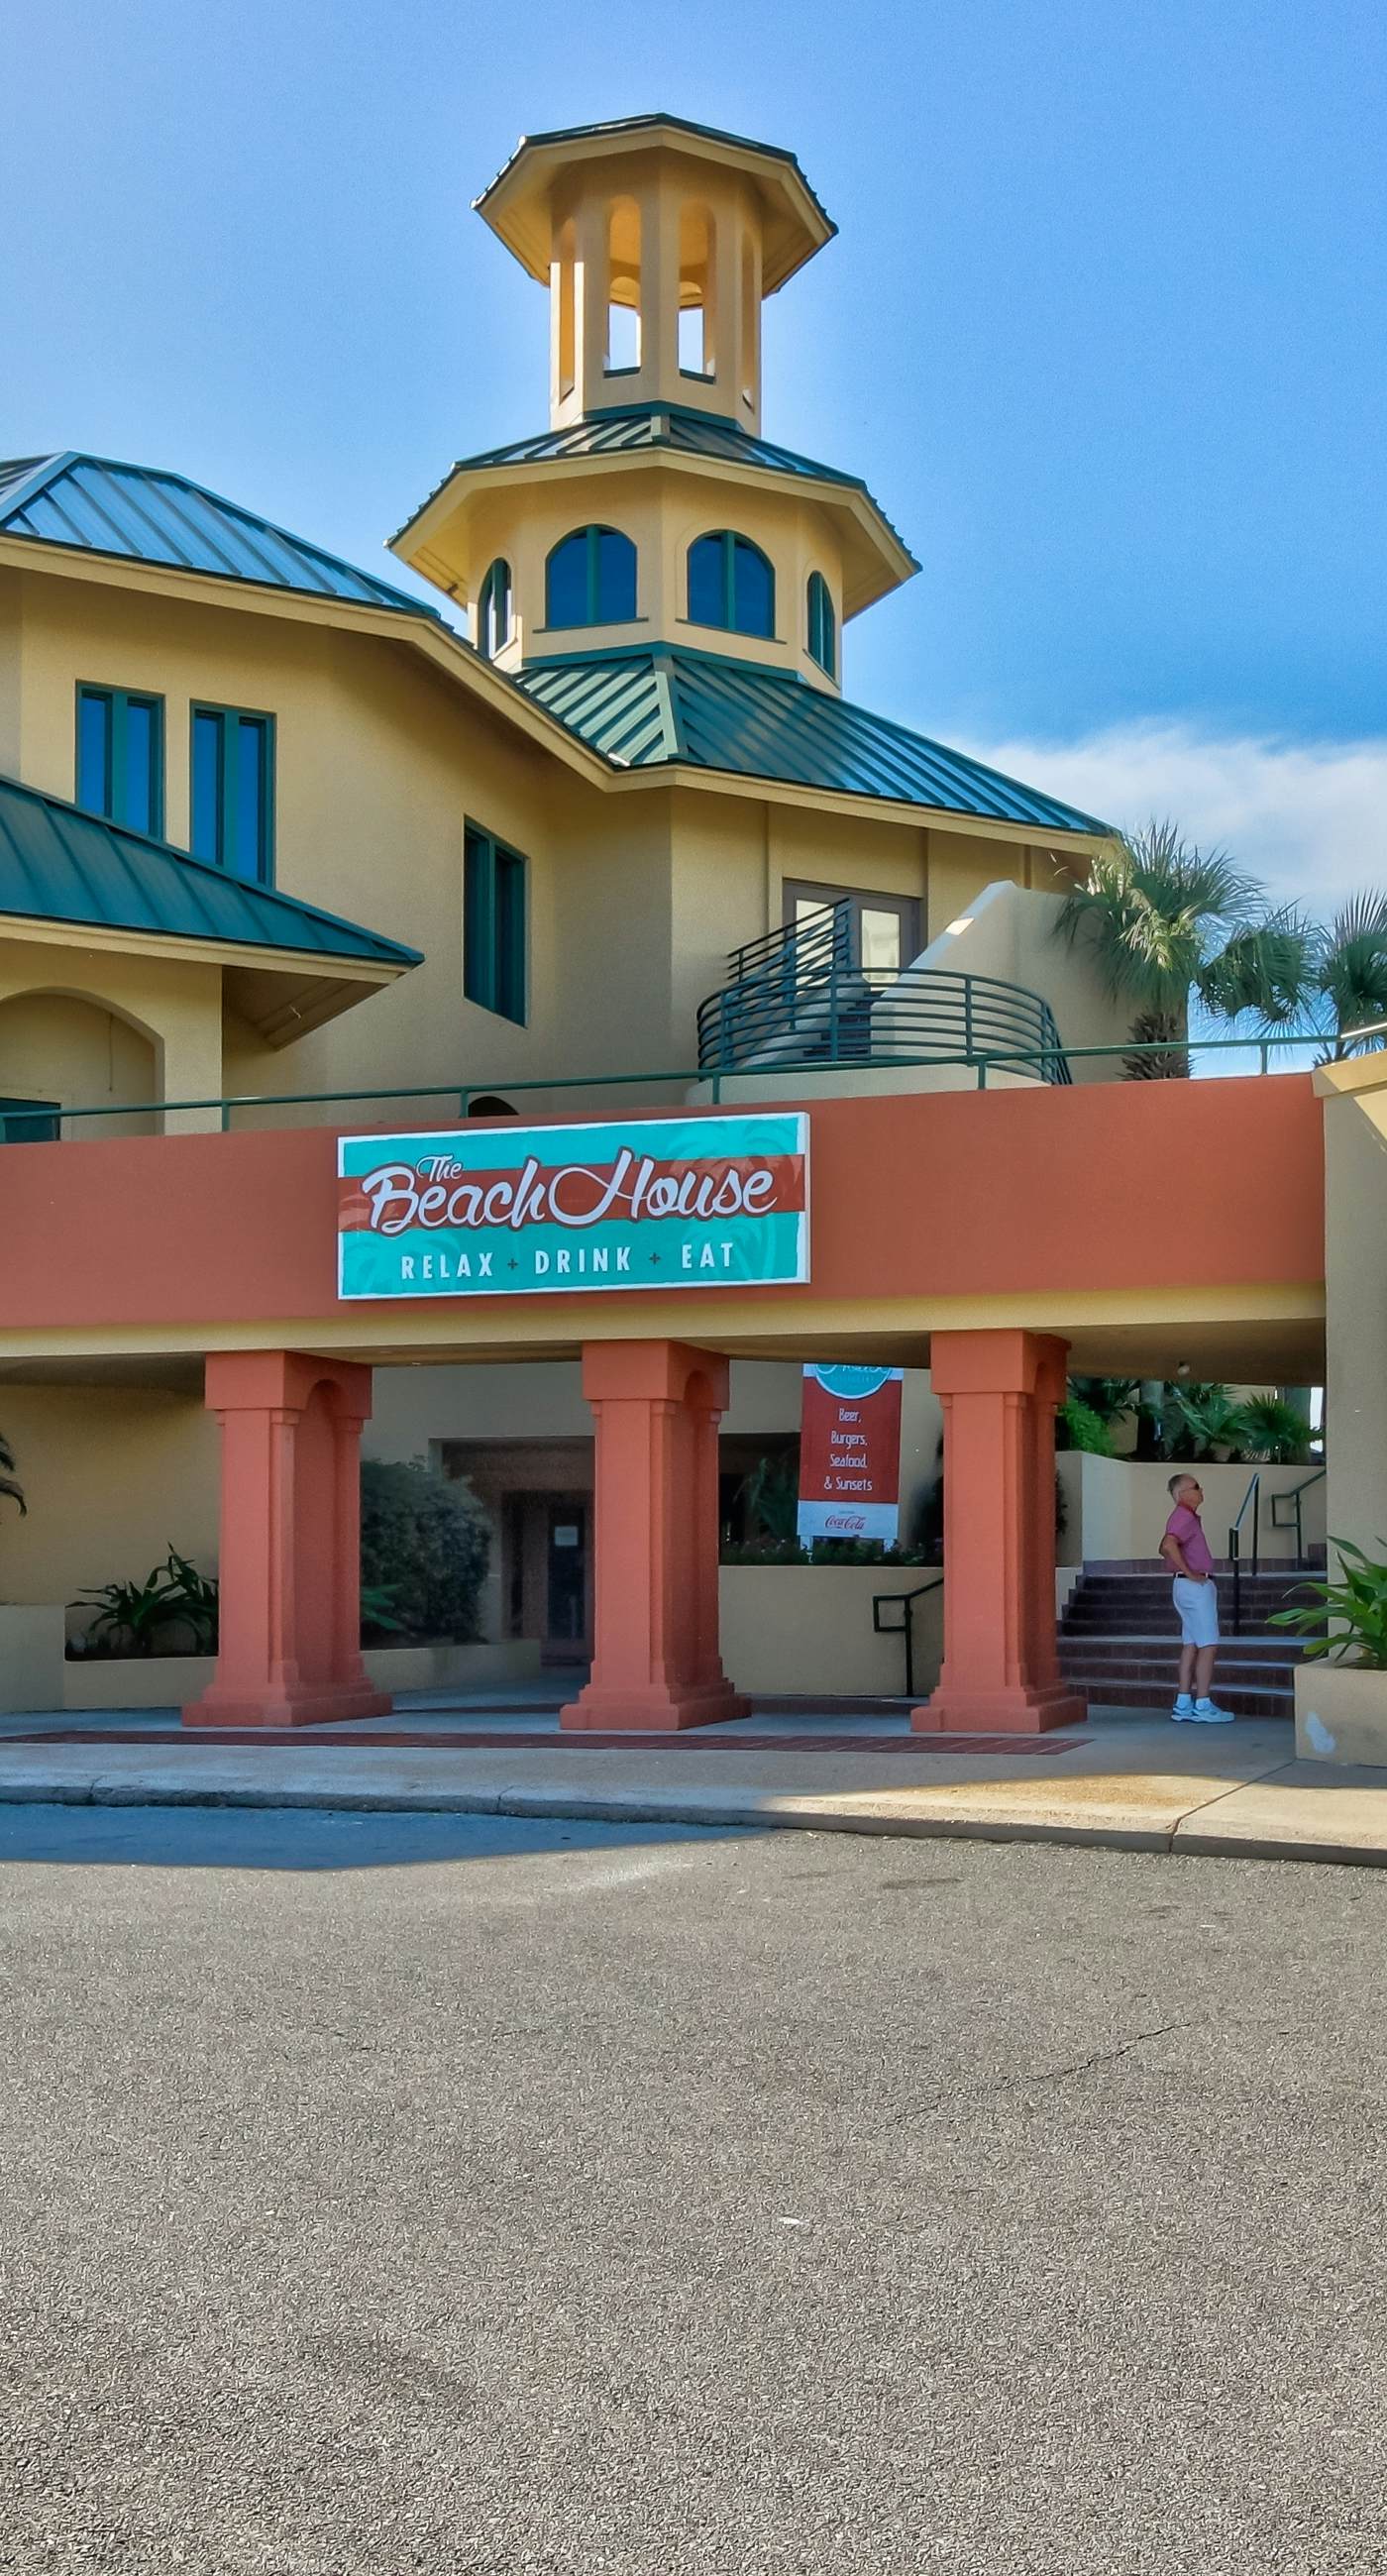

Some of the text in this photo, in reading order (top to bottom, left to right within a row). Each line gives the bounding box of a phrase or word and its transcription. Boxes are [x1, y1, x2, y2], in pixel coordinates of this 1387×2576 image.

[416, 1154, 463, 1182] The
[362, 1147, 778, 1235] Beach House
[401, 1241, 734, 1280] RELAX DRINK EAT
[838, 1407, 862, 1423] Beer,
[823, 1475, 873, 1491] & Sunsets
